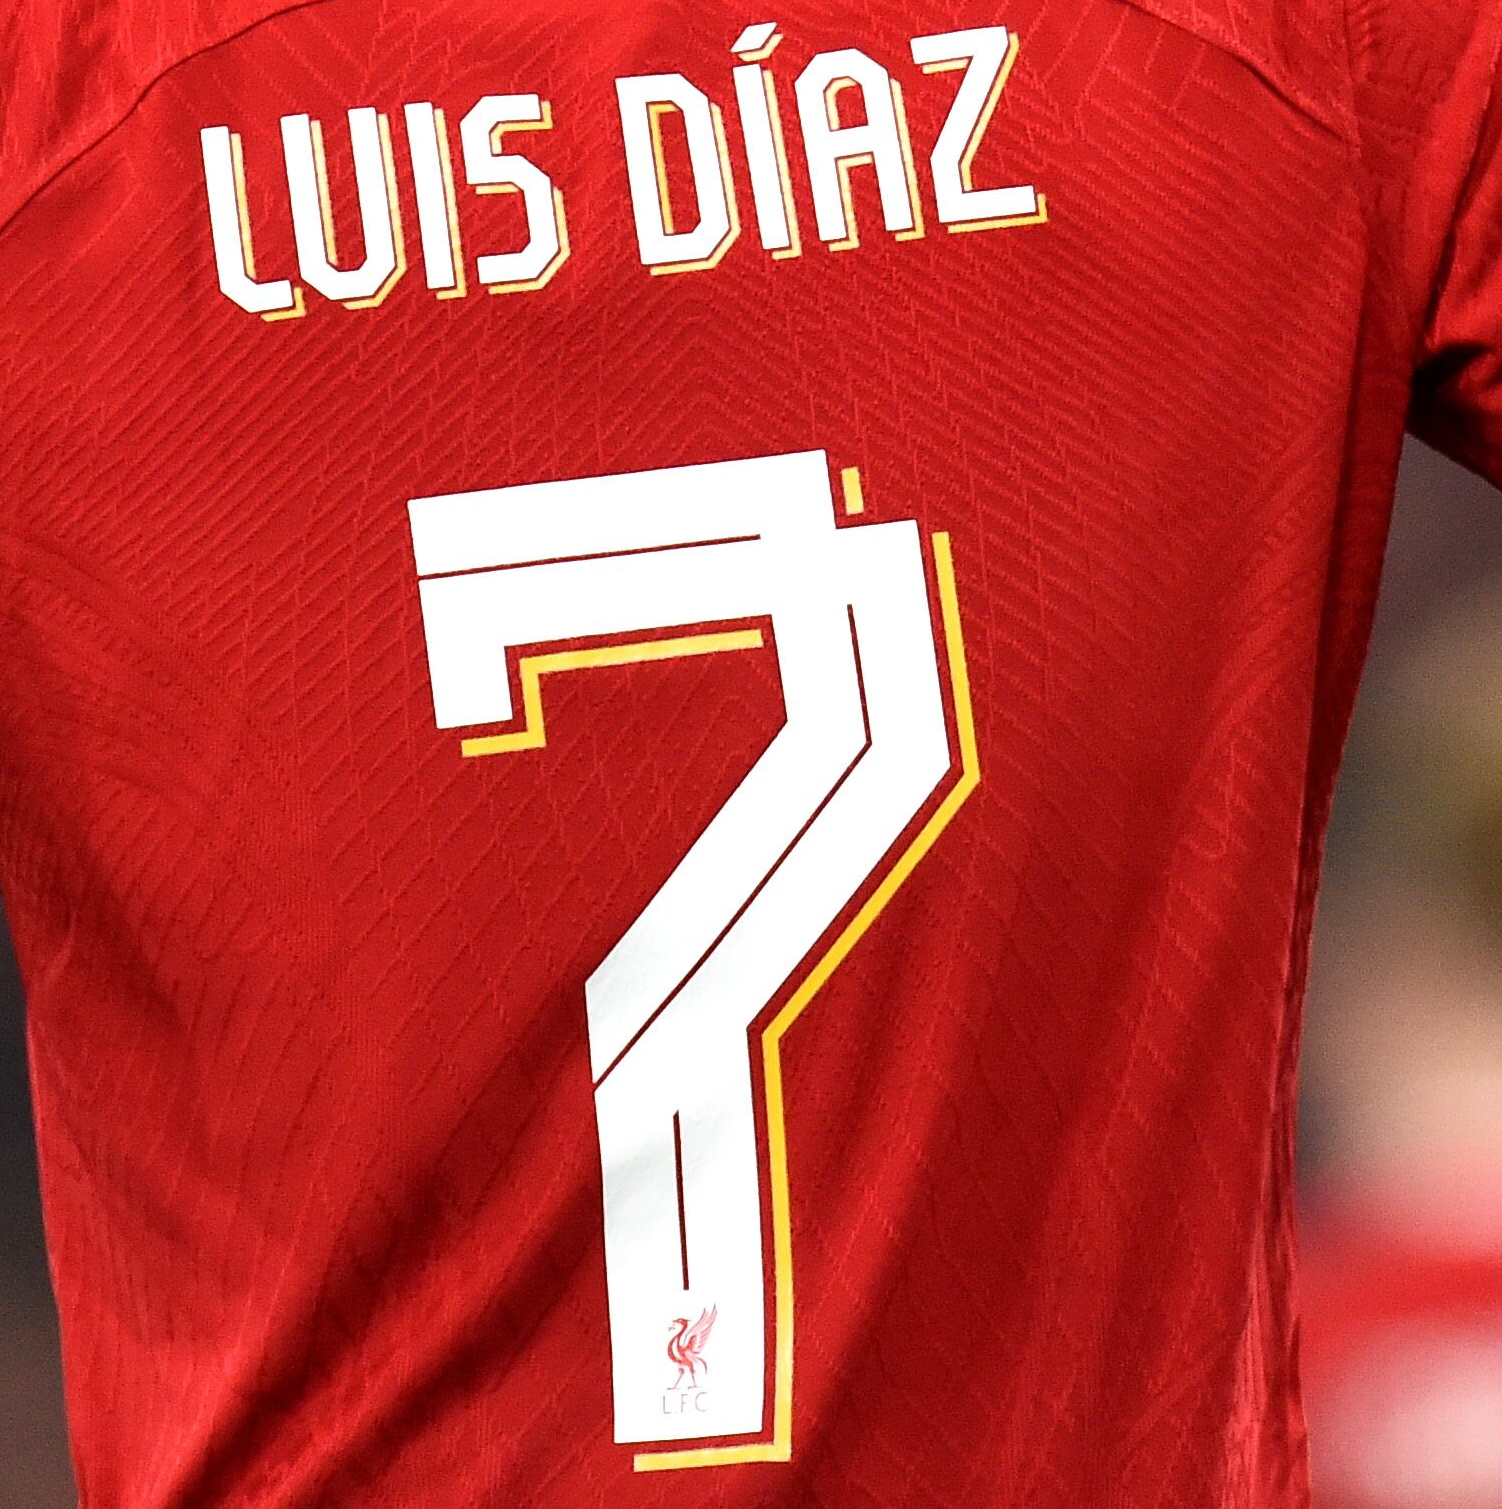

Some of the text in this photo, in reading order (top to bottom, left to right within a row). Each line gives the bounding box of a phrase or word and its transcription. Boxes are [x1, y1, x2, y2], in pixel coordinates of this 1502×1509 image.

[200, 21, 1049, 322] LUIS DÍAZ
[406, 448, 980, 1472] 7
